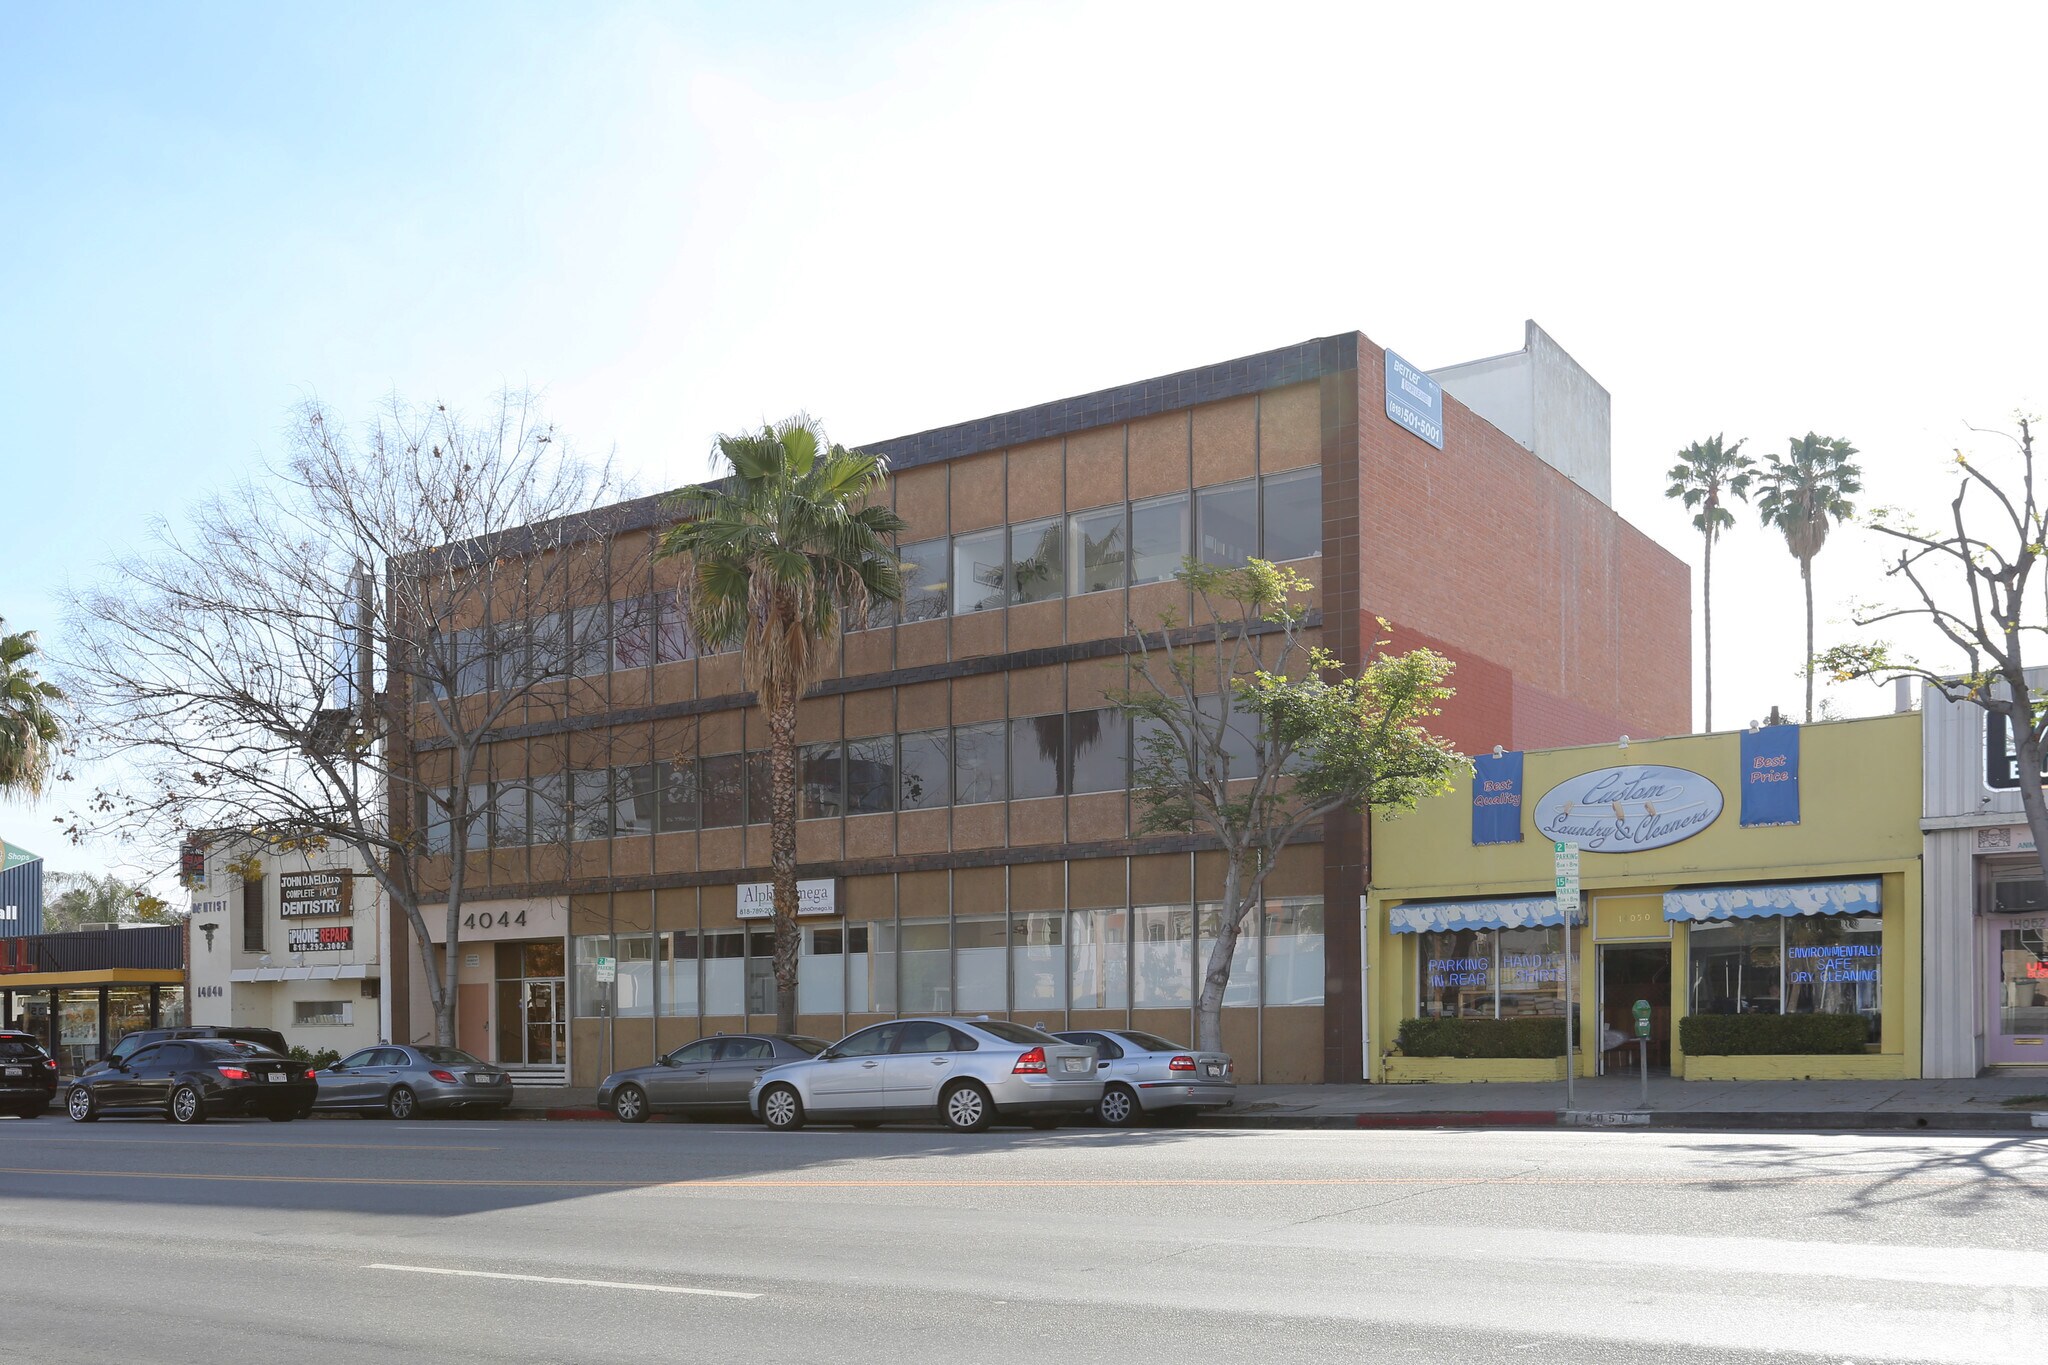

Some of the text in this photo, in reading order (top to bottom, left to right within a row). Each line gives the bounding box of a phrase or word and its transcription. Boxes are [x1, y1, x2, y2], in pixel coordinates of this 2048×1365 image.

[1753, 755, 1787, 768] Best
[1751, 770, 1789, 784] Price
[1484, 779, 1512, 792] Best
[1581, 771, 1664, 804] Custom
[1474, 792, 1520, 807] Quality
[1544, 808, 1713, 848] Laundry & Cleaners
[7, 852, 30, 861] Shops
[281, 876, 301, 887] JOHN
[1557, 878, 1565, 886] 15
[286, 888, 315, 898] COMPLETE
[744, 885, 828, 906] Alph mega
[282, 899, 341, 915] DENTISTRY
[1619, 914, 1650, 923] 1050
[289, 927, 349, 944] iPHONE REPAIR
[1788, 945, 1882, 958] ENVIRONMENTALLY
[1428, 957, 1488, 971] PARKING
[1503, 954, 1542, 968] HAND
[1817, 958, 1851, 970] SAFE
[1431, 972, 1486, 987] IN REAR
[1516, 967, 1567, 982] SHIRTS
[1791, 969, 1879, 982] DRY CLEANING
